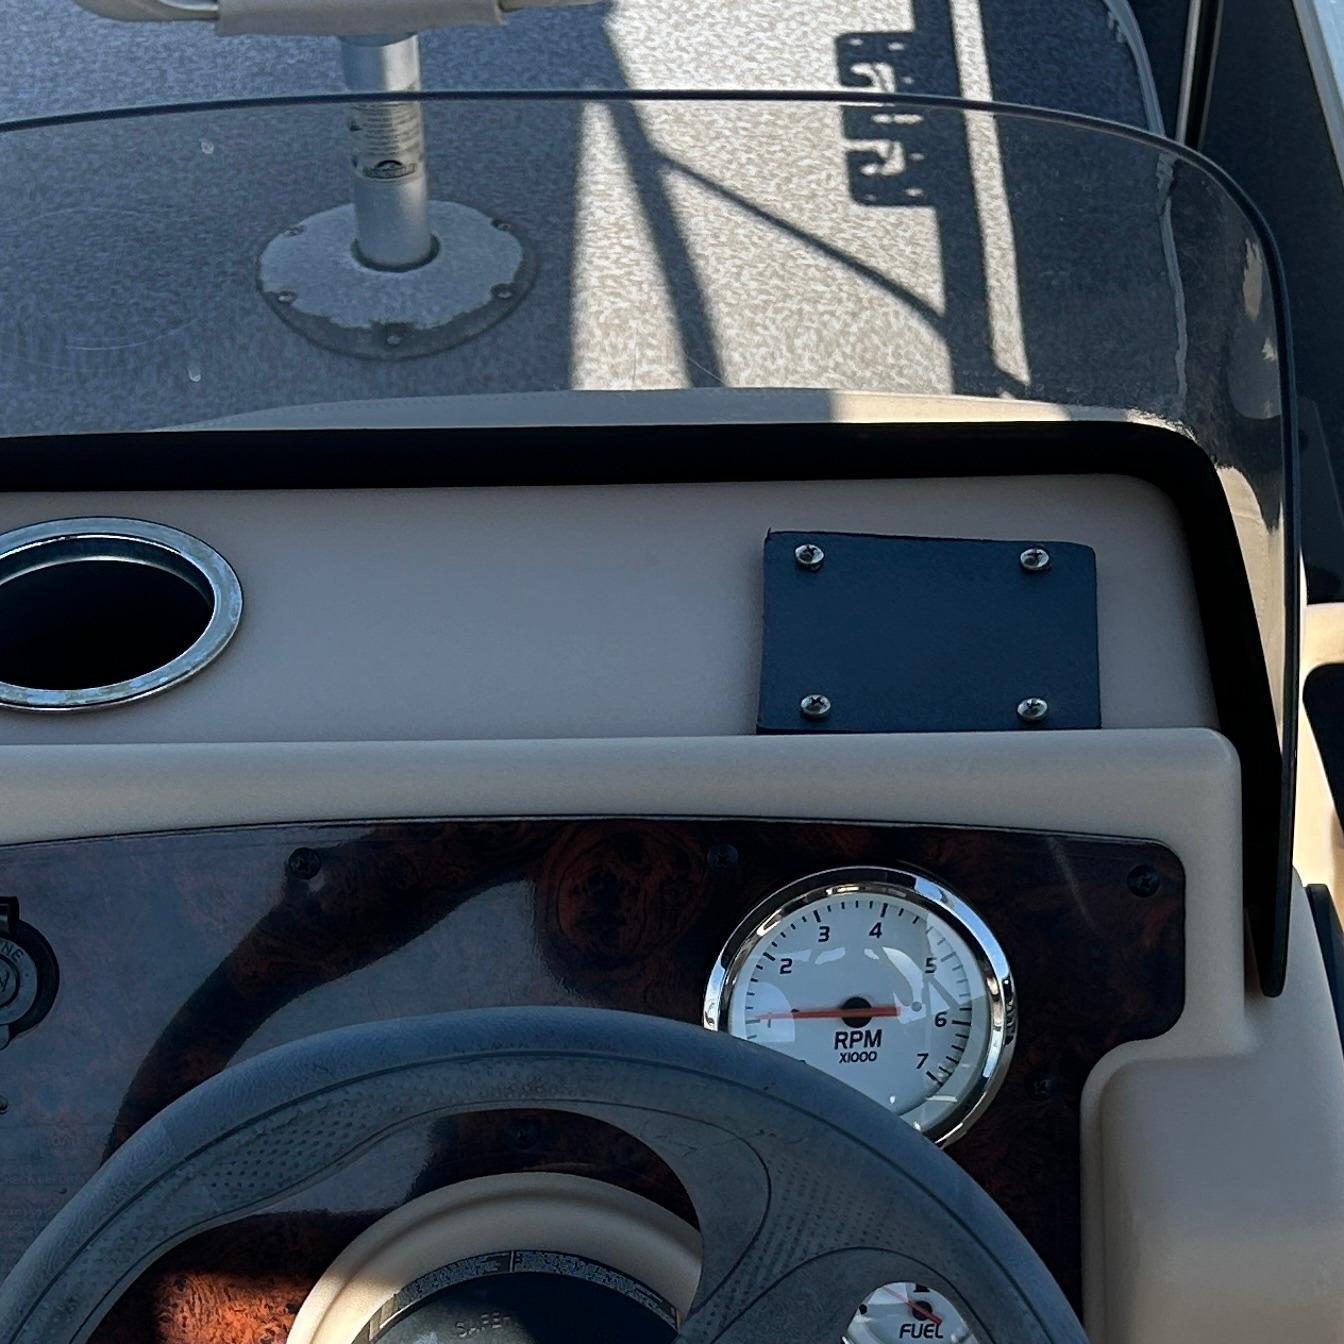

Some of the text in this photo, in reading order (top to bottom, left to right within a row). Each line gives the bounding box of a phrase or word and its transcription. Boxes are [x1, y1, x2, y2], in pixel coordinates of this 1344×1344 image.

[817, 926, 830, 942] 3
[868, 922, 883, 939] 4
[779, 958, 793, 974] 2
[924, 957, 937, 974] 5
[934, 1011, 947, 1027] 6
[833, 1029, 883, 1050] RPM
[838, 1051, 878, 1064] X1000
[916, 1053, 929, 1069] 7
[899, 1323, 944, 1339] FUEL
